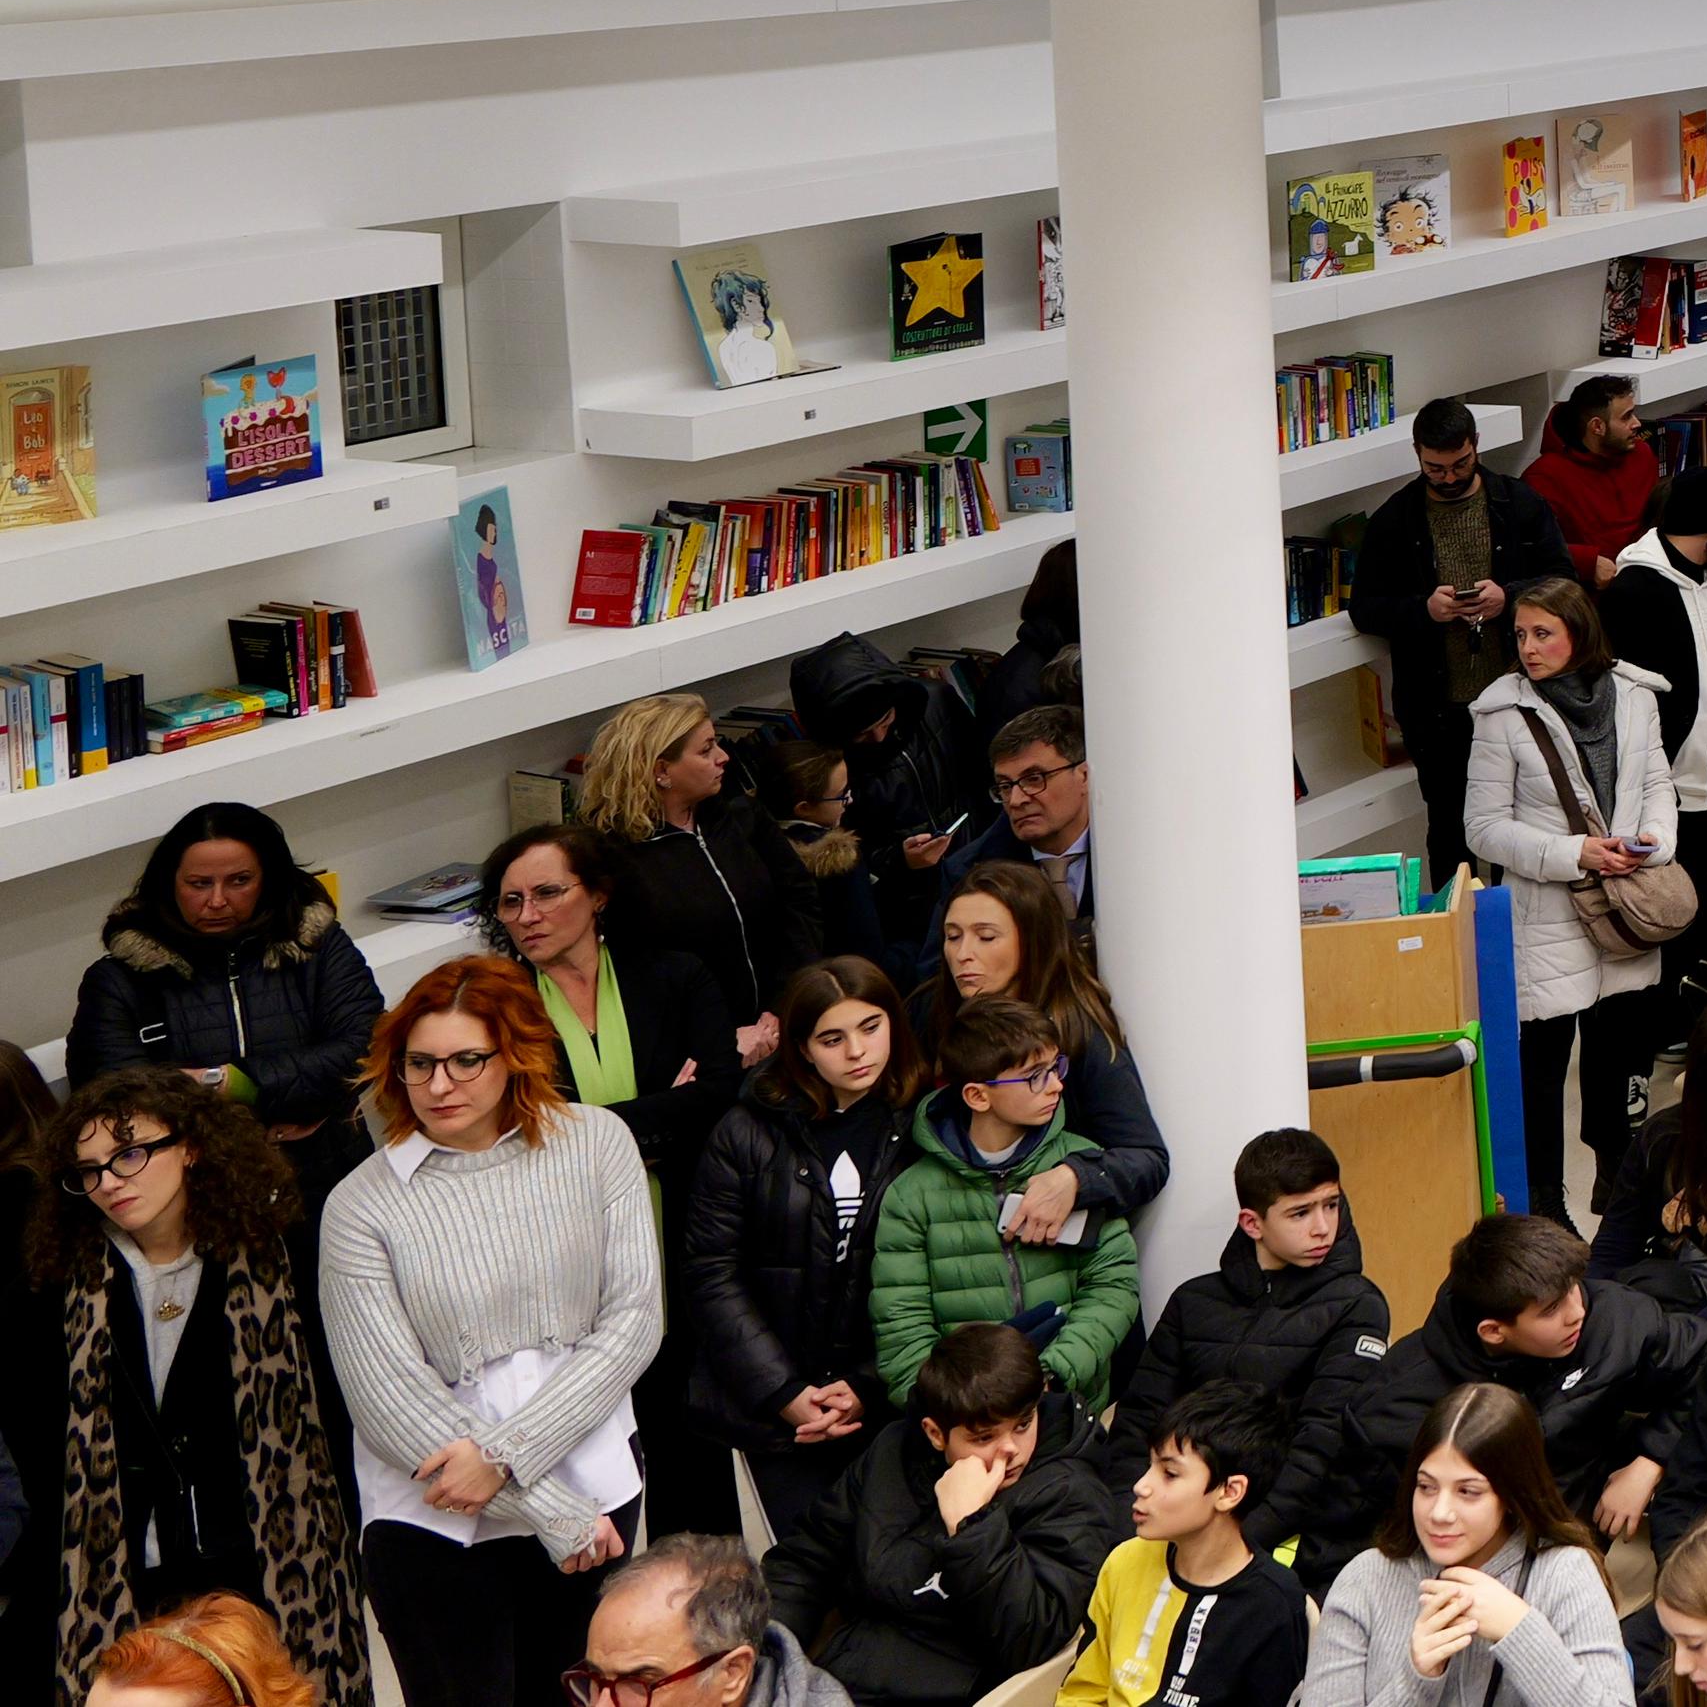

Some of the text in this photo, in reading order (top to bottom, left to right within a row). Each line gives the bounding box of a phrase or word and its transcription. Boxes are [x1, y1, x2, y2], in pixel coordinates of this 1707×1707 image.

[1326, 197, 1369, 221] AZZURRO
[952, 321, 974, 335] STELLE
[238, 420, 297, 447] L'ISOLA
[231, 437, 307, 469] DESSERT
[476, 621, 526, 656] NASCITA
